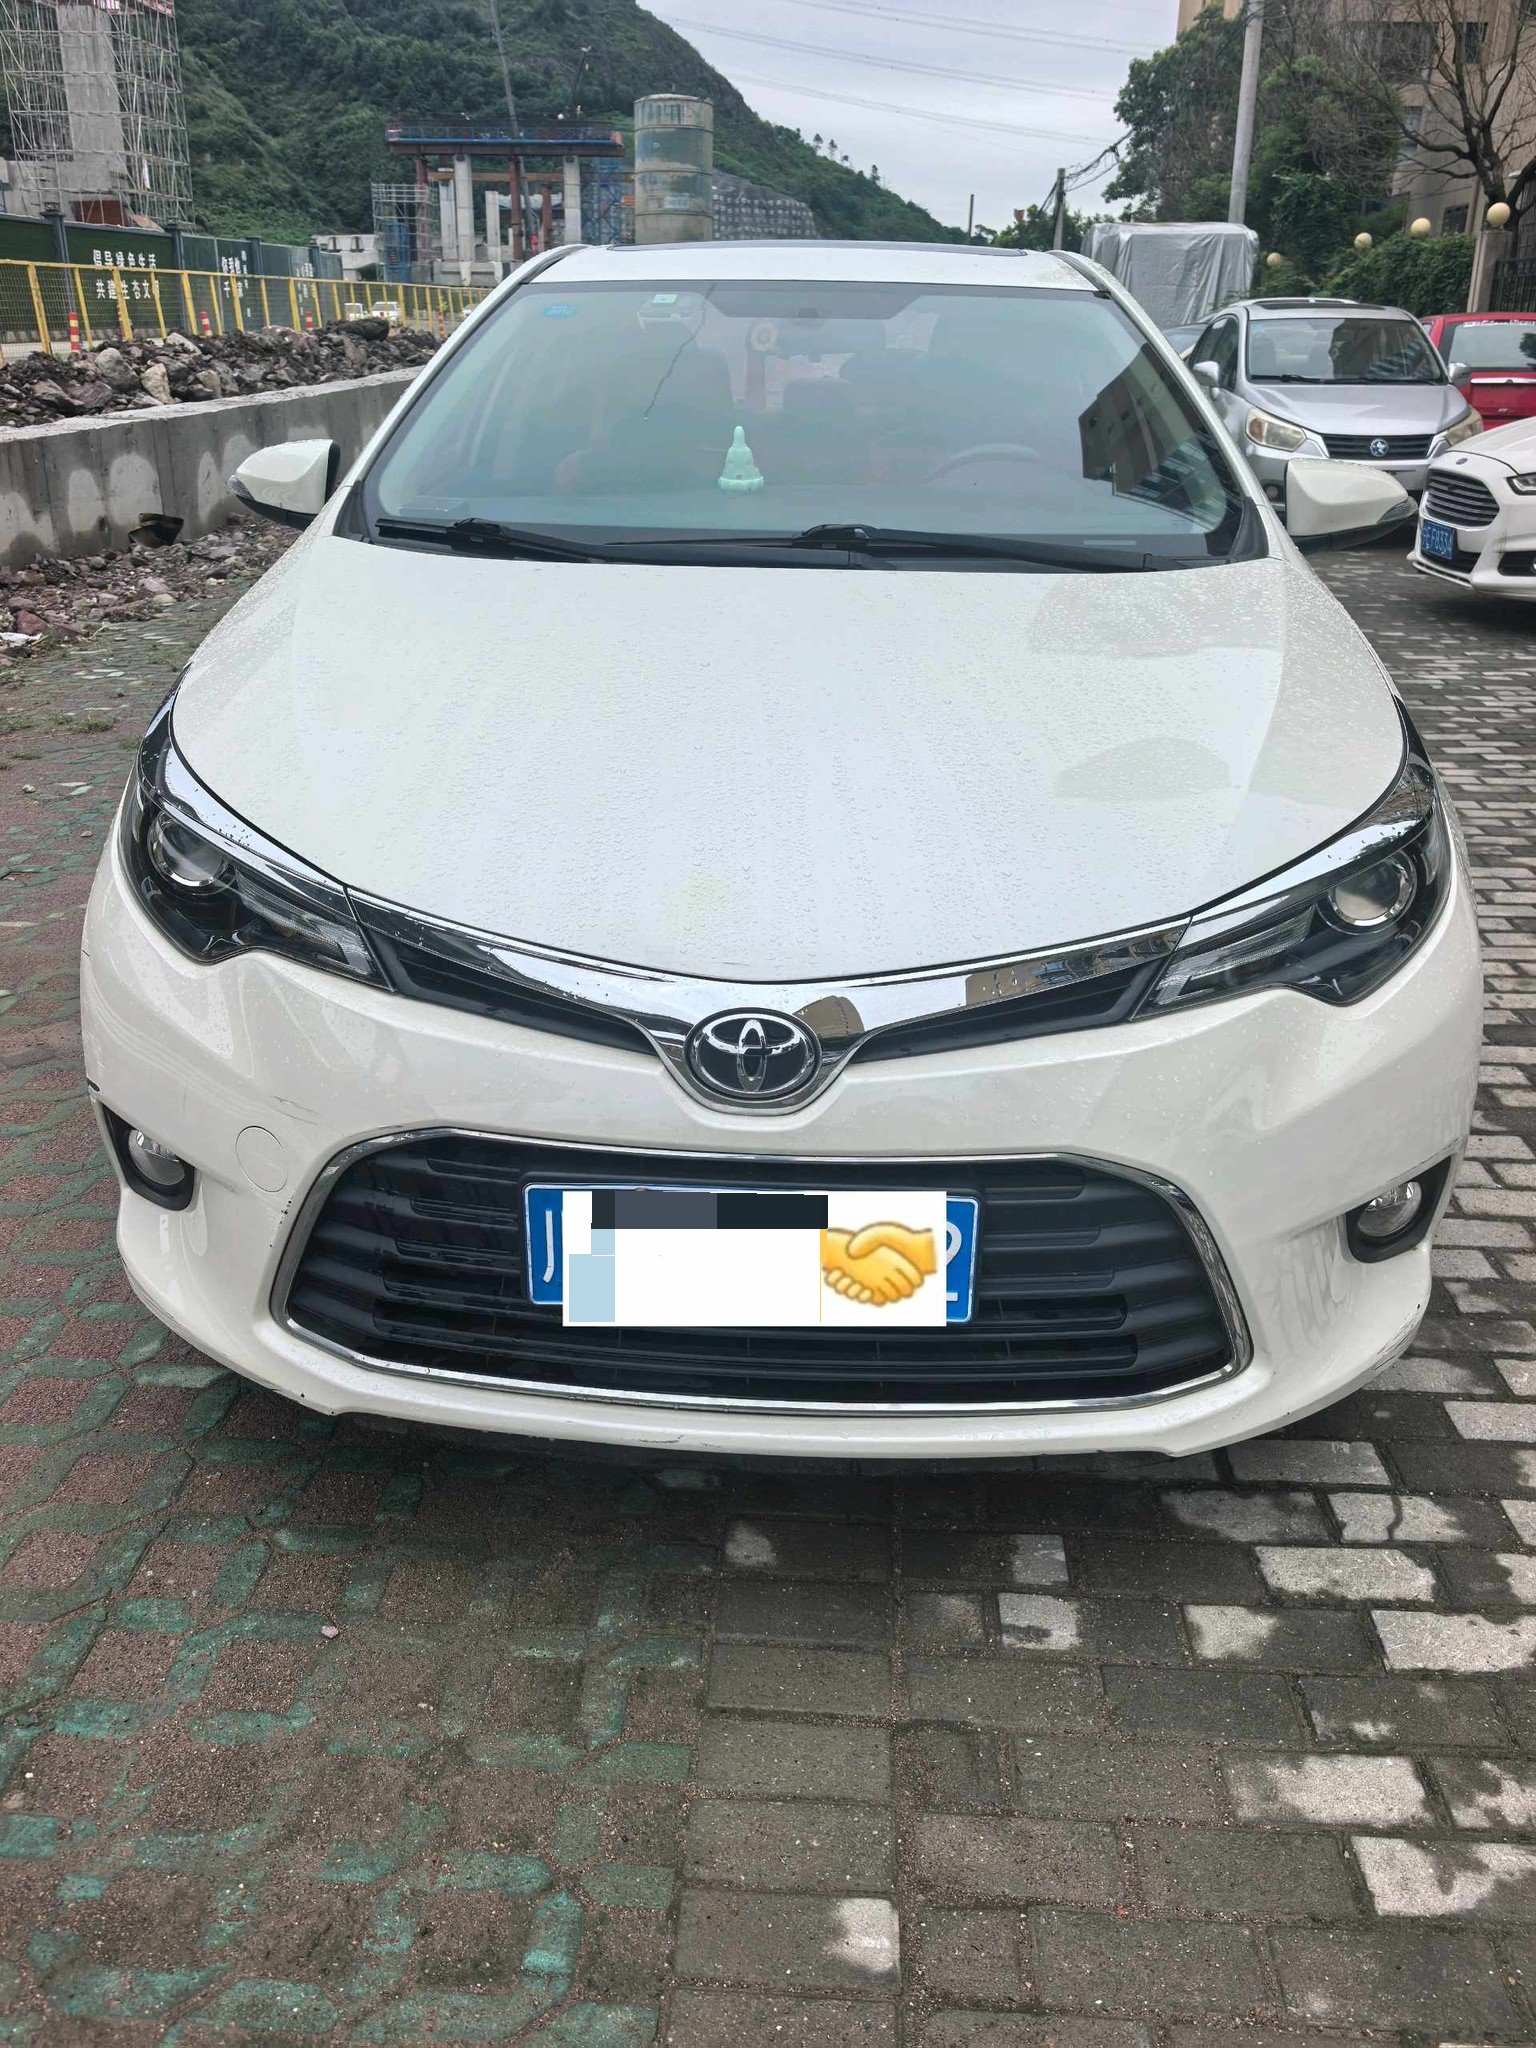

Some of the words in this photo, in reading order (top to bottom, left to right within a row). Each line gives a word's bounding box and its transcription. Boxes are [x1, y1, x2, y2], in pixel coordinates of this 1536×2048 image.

[95, 279, 159, 300] 共建生态文
